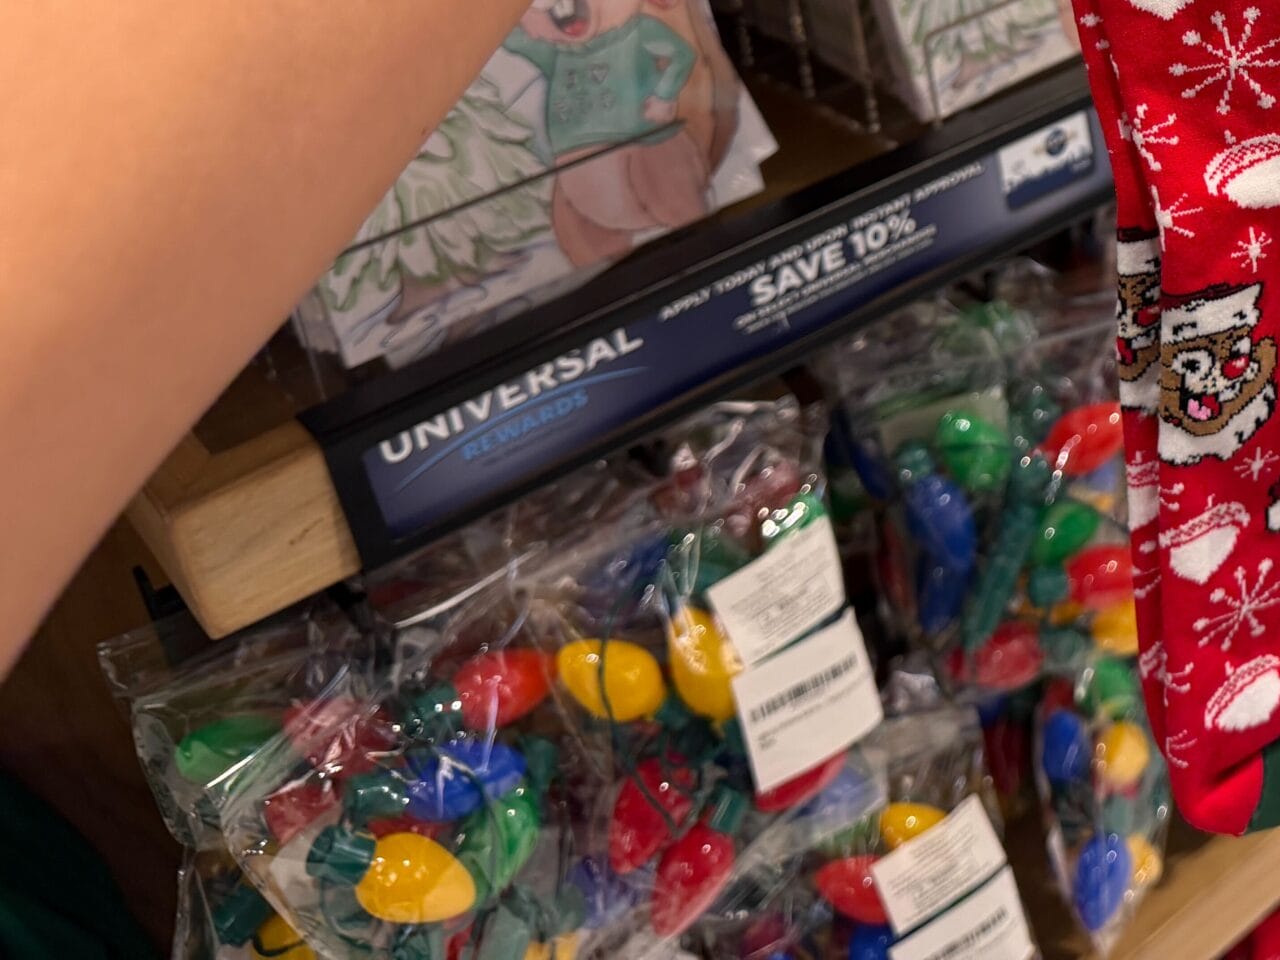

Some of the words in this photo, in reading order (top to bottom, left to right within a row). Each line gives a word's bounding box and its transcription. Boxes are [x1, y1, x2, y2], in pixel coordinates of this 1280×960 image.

[658, 288, 712, 321] APPLY
[715, 261, 767, 294] TODAY
[769, 244, 804, 269] AND
[805, 223, 848, 253] UPON
[851, 193, 912, 230] INSTANT
[912, 161, 985, 202] APPROVAL
[750, 242, 847, 307] SAVE
[848, 208, 917, 258] 10%
[379, 328, 644, 464] UNIVERSAL
[462, 387, 589, 461] REWARDS
